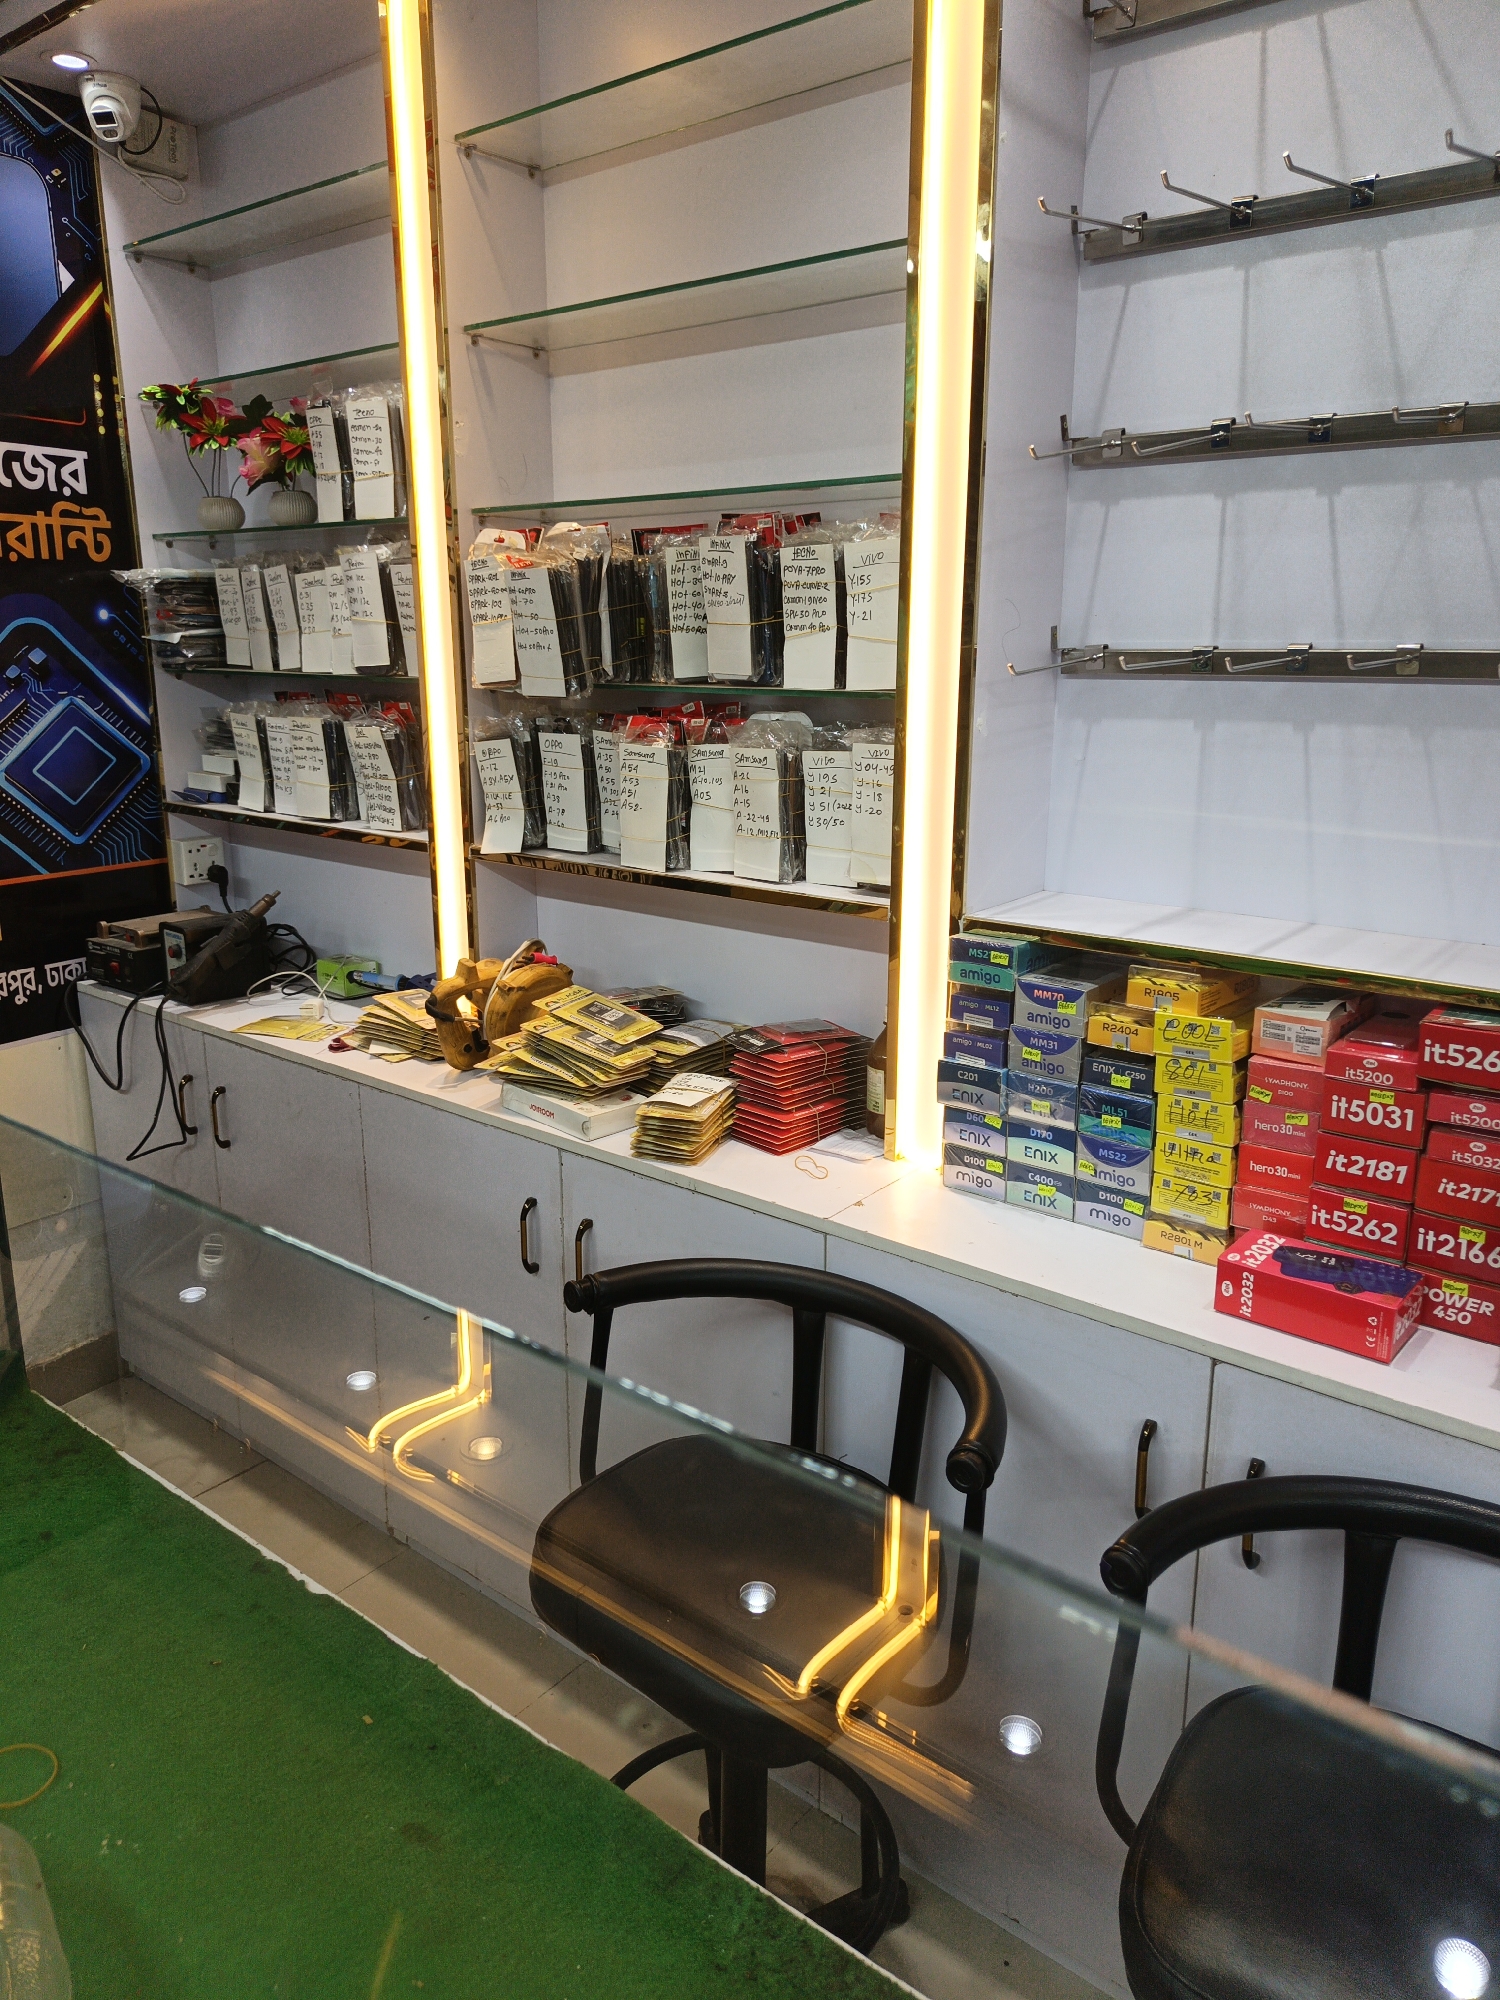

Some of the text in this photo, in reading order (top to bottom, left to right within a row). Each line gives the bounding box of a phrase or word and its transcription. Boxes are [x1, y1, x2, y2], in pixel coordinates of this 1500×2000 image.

[0, 501, 111, 562] রান্টি
[968, 948, 990, 959] MS2
[960, 967, 1000, 985] amigo
[1034, 989, 1064, 1001] MM70
[1144, 988, 1180, 1002] R1805
[958, 1000, 978, 1008] amigo
[1027, 1011, 1070, 1029] amigo
[1102, 1022, 1139, 1036] R2404
[952, 1036, 972, 1046] amigo
[1030, 1036, 1058, 1050] MM31
[1022, 1058, 1064, 1075] amigo
[1092, 1062, 1146, 1080] ENIX C250
[957, 1070, 978, 1082] C201
[1345, 1067, 1393, 1085] it5200
[952, 1088, 984, 1105] ENIX
[1027, 1083, 1054, 1096] H200
[1101, 1104, 1128, 1118] ML51
[1331, 1094, 1414, 1132] it5031
[959, 1129, 991, 1147] ENIX
[1030, 1128, 1052, 1140] D170
[964, 1155, 985, 1167] D100
[1024, 1145, 1058, 1165] ENIX
[1099, 1148, 1127, 1162] MS22
[1326, 1150, 1408, 1185] it2181
[956, 1171, 992, 1188] migo
[1028, 1172, 1054, 1186] C400
[1099, 1192, 1123, 1204] D100
[1089, 1207, 1131, 1227] migo
[1311, 1205, 1398, 1245] it5262
[1160, 1231, 1203, 1249] R2801 M
[1241, 1234, 1286, 1269] it2032
[1239, 1272, 1254, 1317] it2032
[1433, 1306, 1472, 1325] 450
